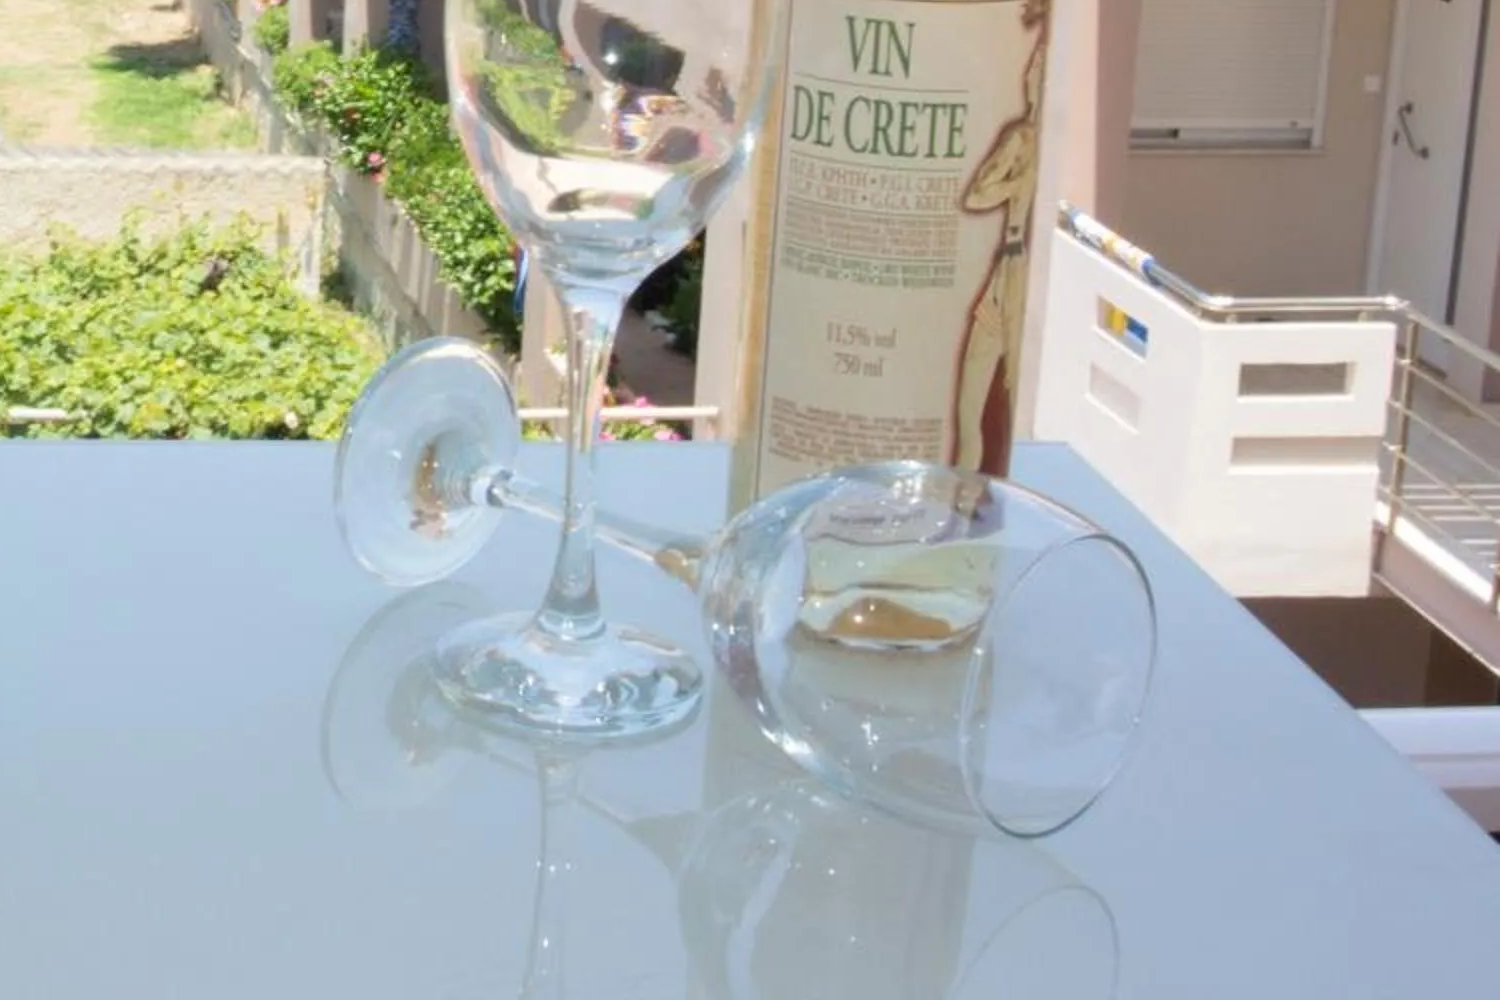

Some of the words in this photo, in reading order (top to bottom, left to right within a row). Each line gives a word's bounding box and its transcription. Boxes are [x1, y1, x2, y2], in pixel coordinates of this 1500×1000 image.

[845, 15, 916, 79] VIN
[790, 85, 835, 148] DE
[843, 96, 969, 159] CRETE
[875, 327, 897, 348] vol
[863, 356, 883, 377] ml
